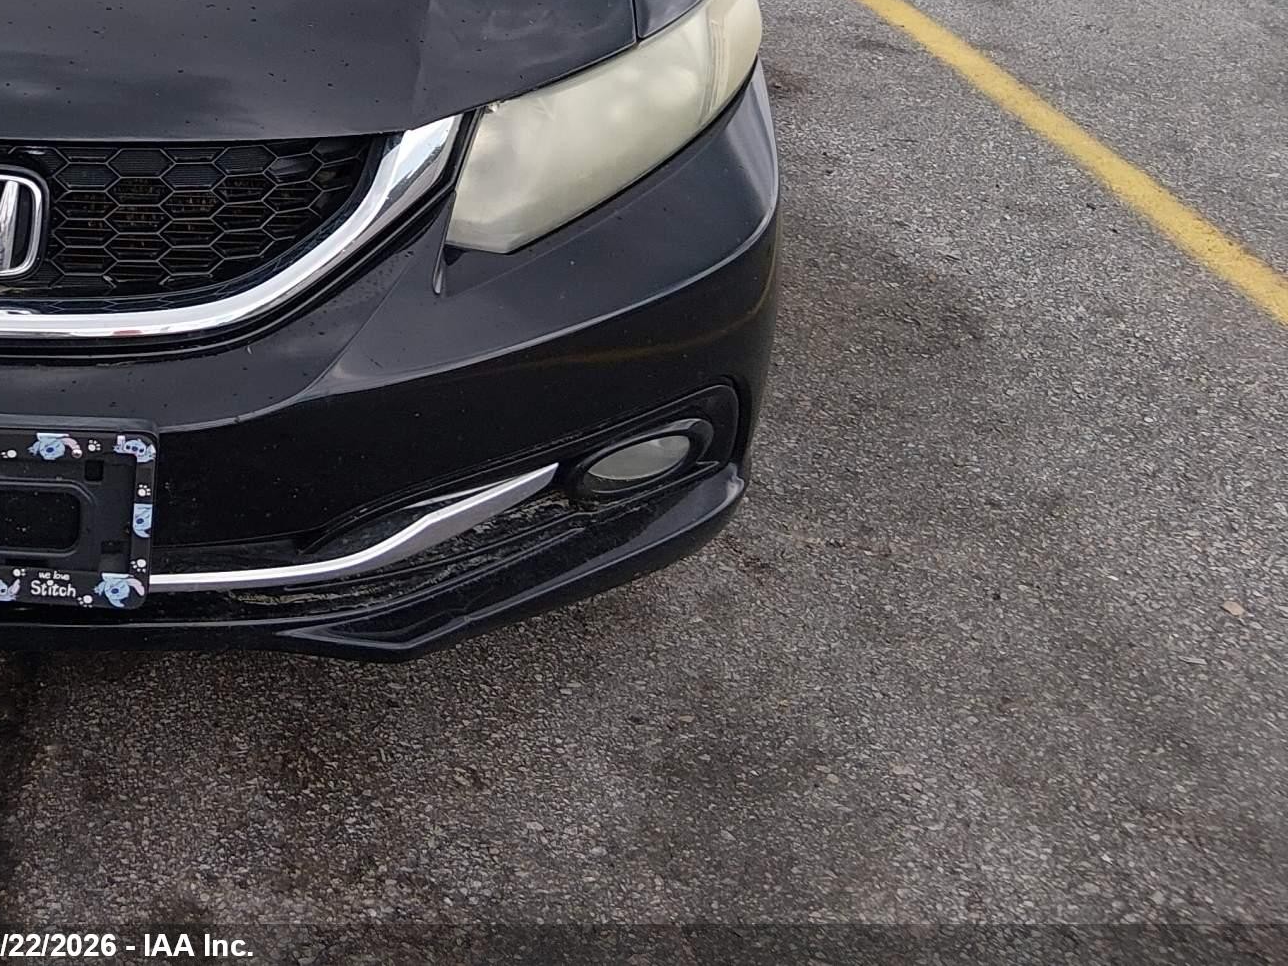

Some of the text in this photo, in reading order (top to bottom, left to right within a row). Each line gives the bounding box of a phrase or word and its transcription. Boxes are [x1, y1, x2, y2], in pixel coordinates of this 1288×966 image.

[38, 571, 70, 581] we love
[30, 580, 76, 597] Stitch
